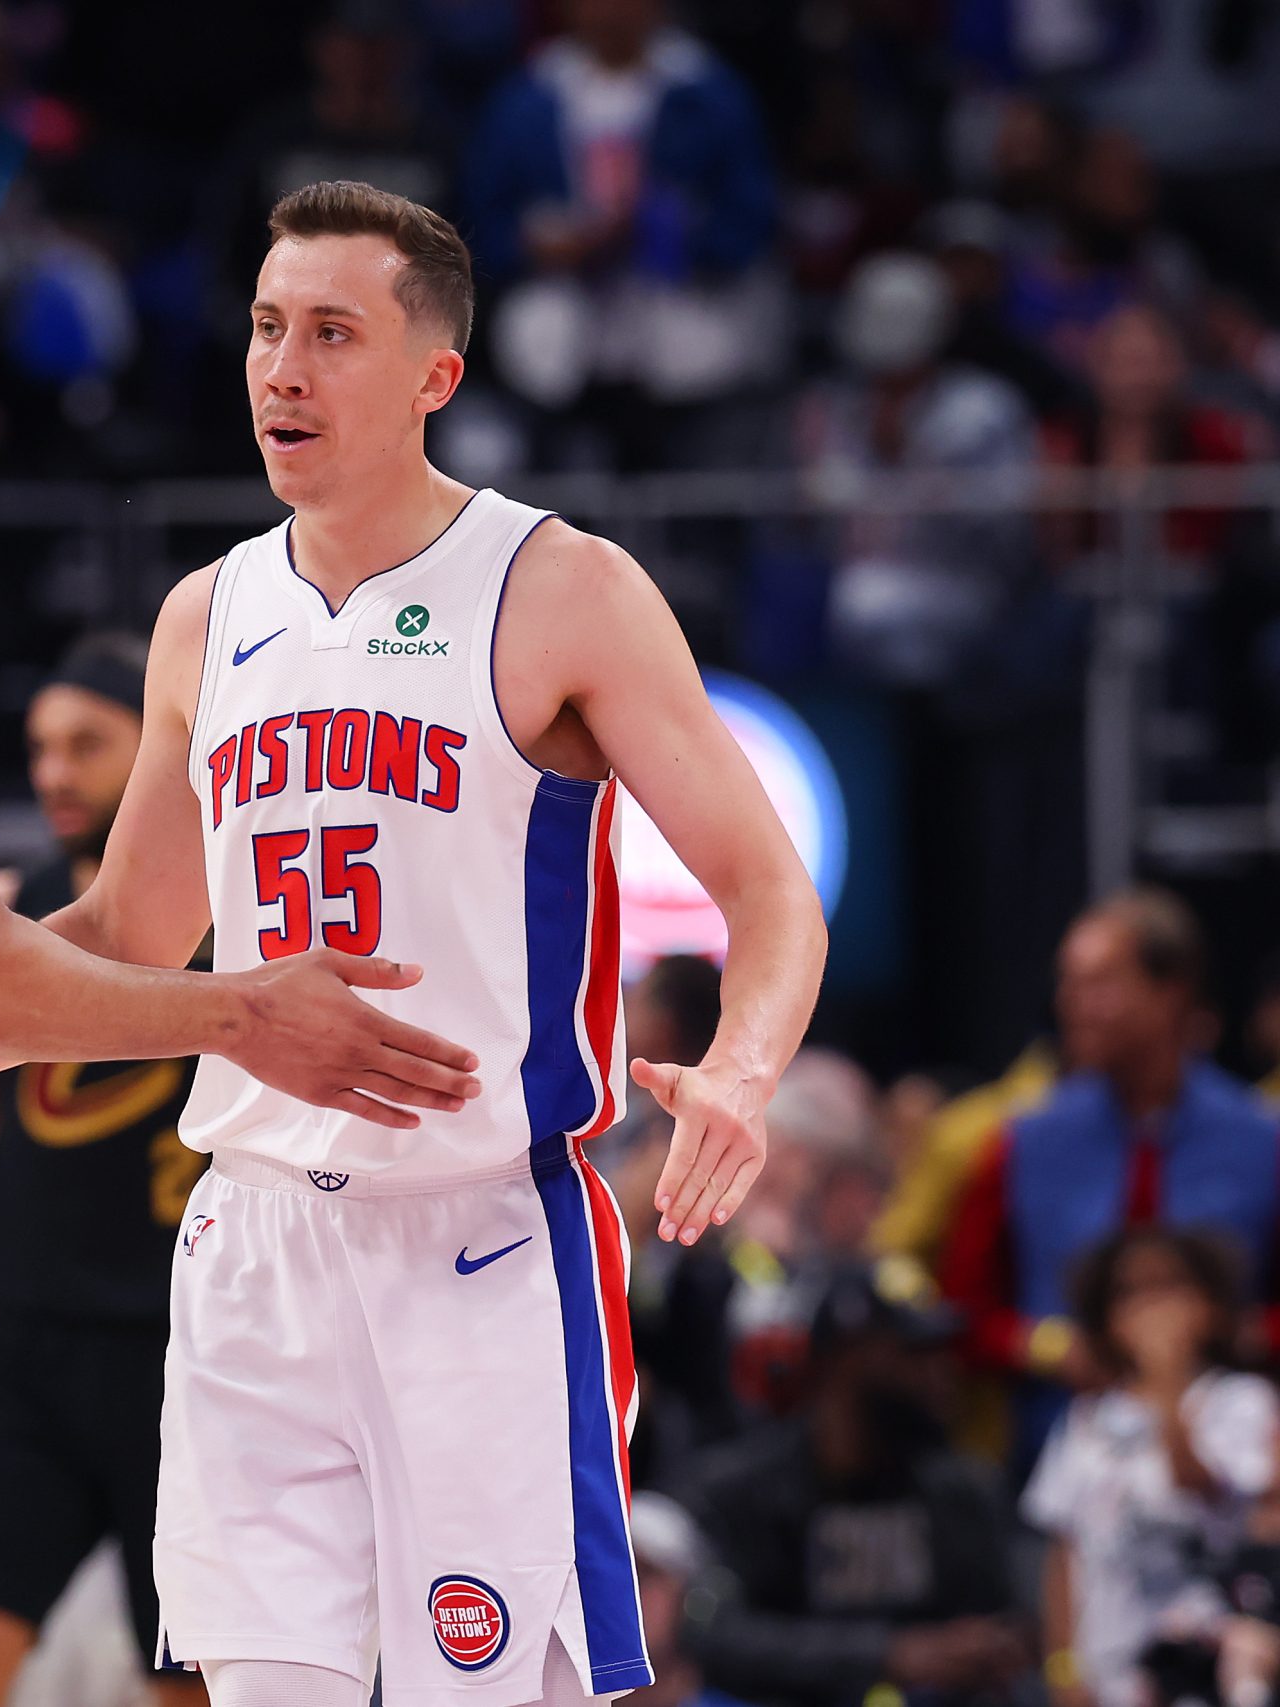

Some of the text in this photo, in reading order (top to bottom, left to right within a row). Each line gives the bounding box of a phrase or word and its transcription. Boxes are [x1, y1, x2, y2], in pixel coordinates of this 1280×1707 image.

[367, 639, 449, 656] StockX
[208, 708, 467, 832] PISTONS
[251, 823, 381, 961] 55
[437, 1605, 486, 1622] DETROIT
[440, 1621, 492, 1638] PISTONS
